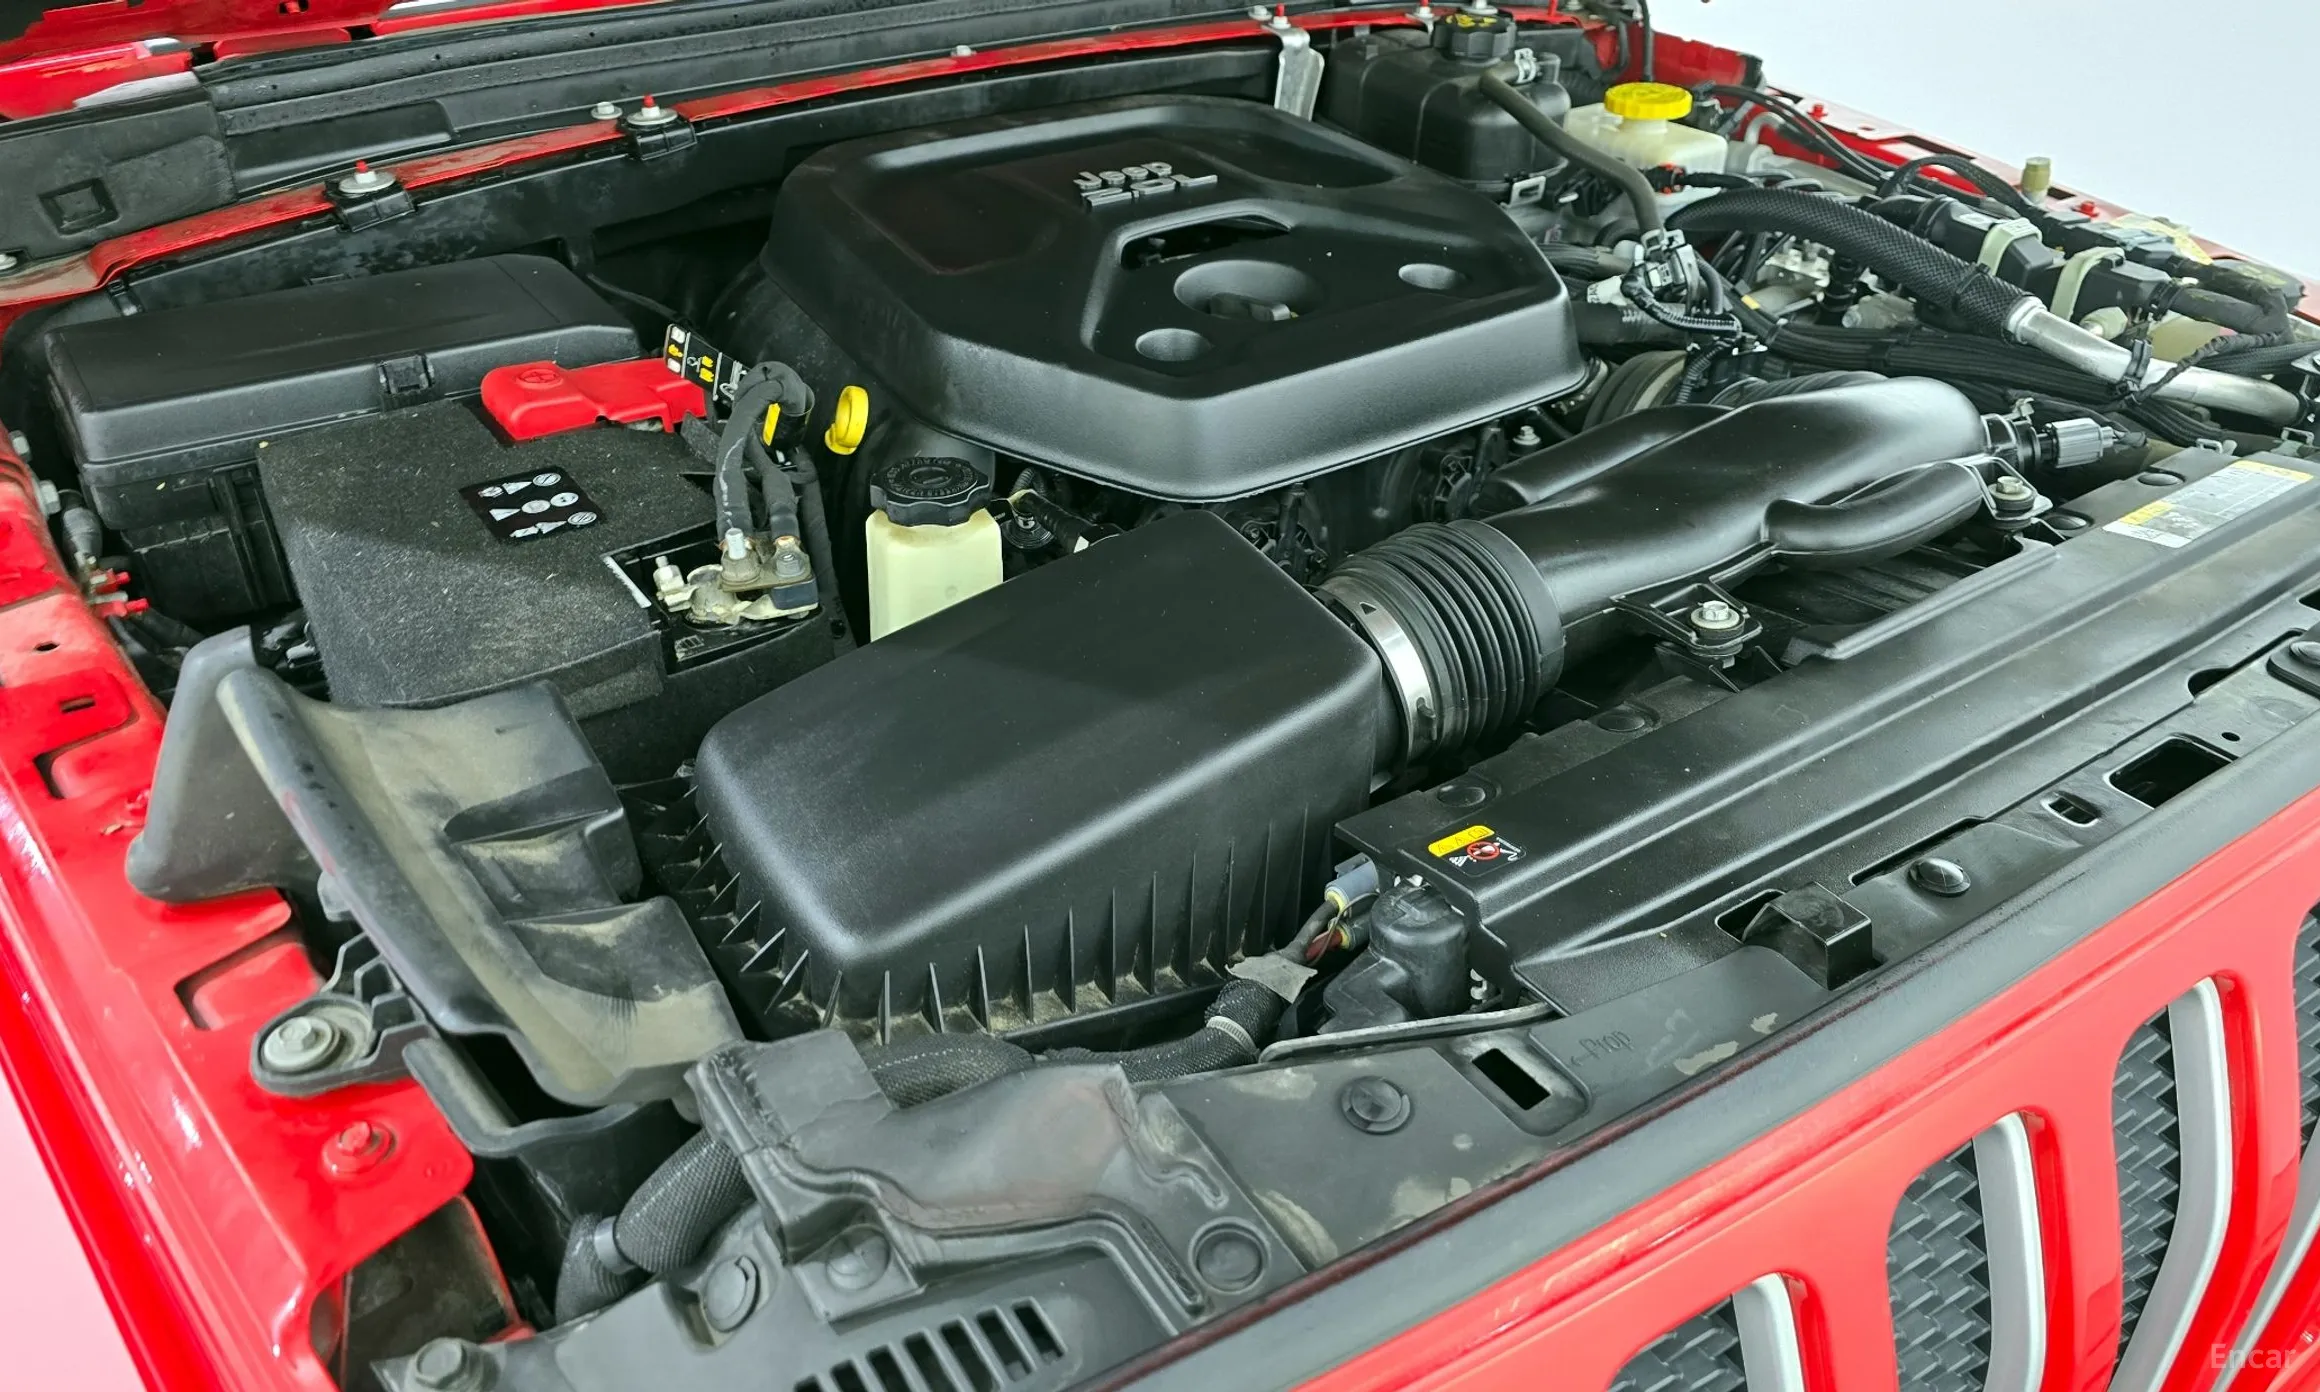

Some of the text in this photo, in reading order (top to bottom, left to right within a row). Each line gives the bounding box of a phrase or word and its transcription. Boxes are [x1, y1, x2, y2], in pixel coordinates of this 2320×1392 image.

[1073, 161, 1172, 190] Jeep
[1081, 174, 1218, 206] 2.0L
[1579, 1031, 1635, 1060] Prop
